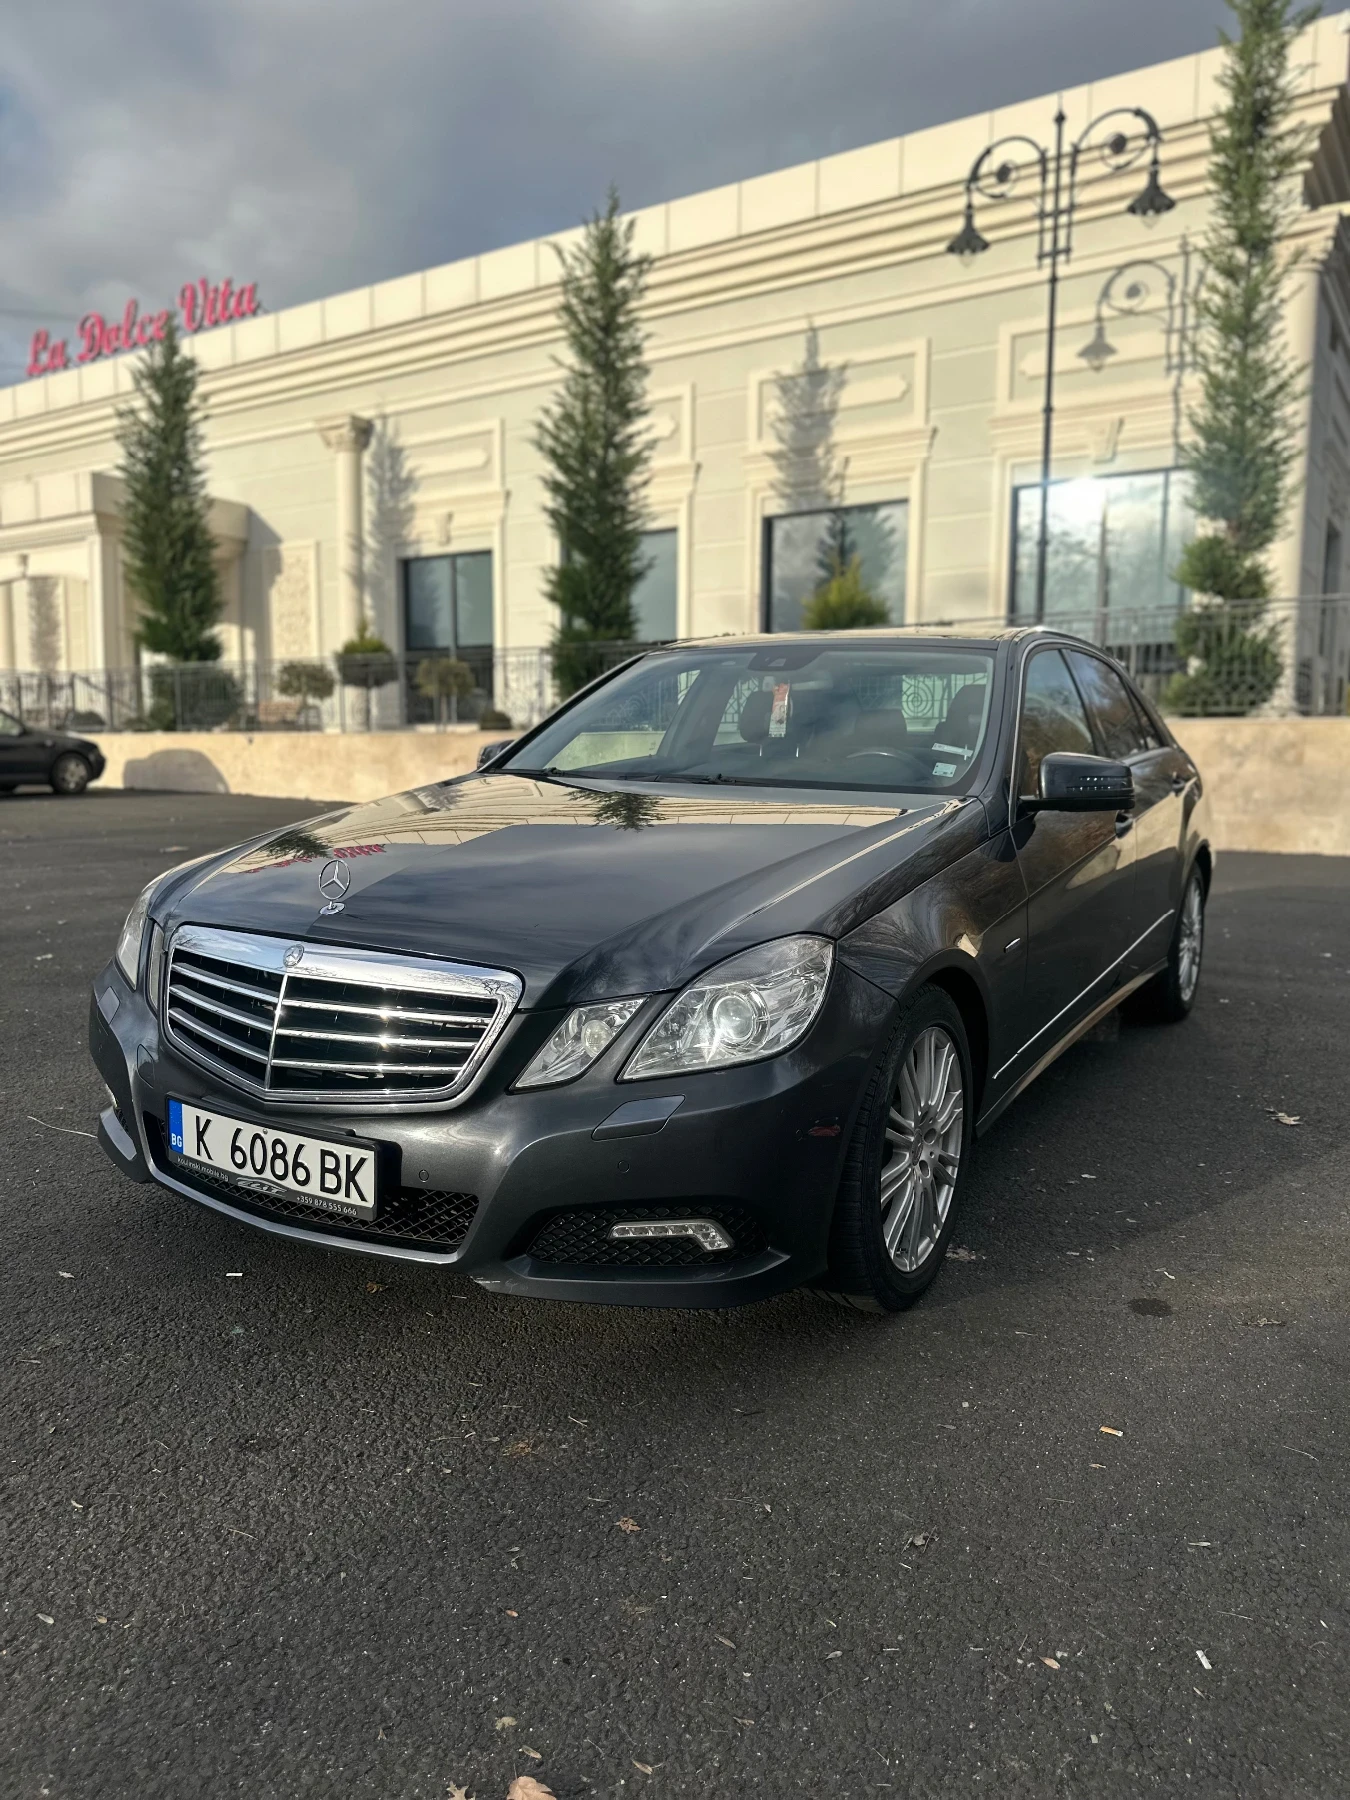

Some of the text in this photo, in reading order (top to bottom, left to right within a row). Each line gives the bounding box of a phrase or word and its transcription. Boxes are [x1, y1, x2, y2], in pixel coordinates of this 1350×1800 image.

[26, 276, 259, 376] La Dolce Vita
[171, 1133, 183, 1146] BG
[195, 1115, 369, 1202] K 6086 BK
[296, 1195, 313, 1204] +359
[328, 1202, 342, 1212] 555
